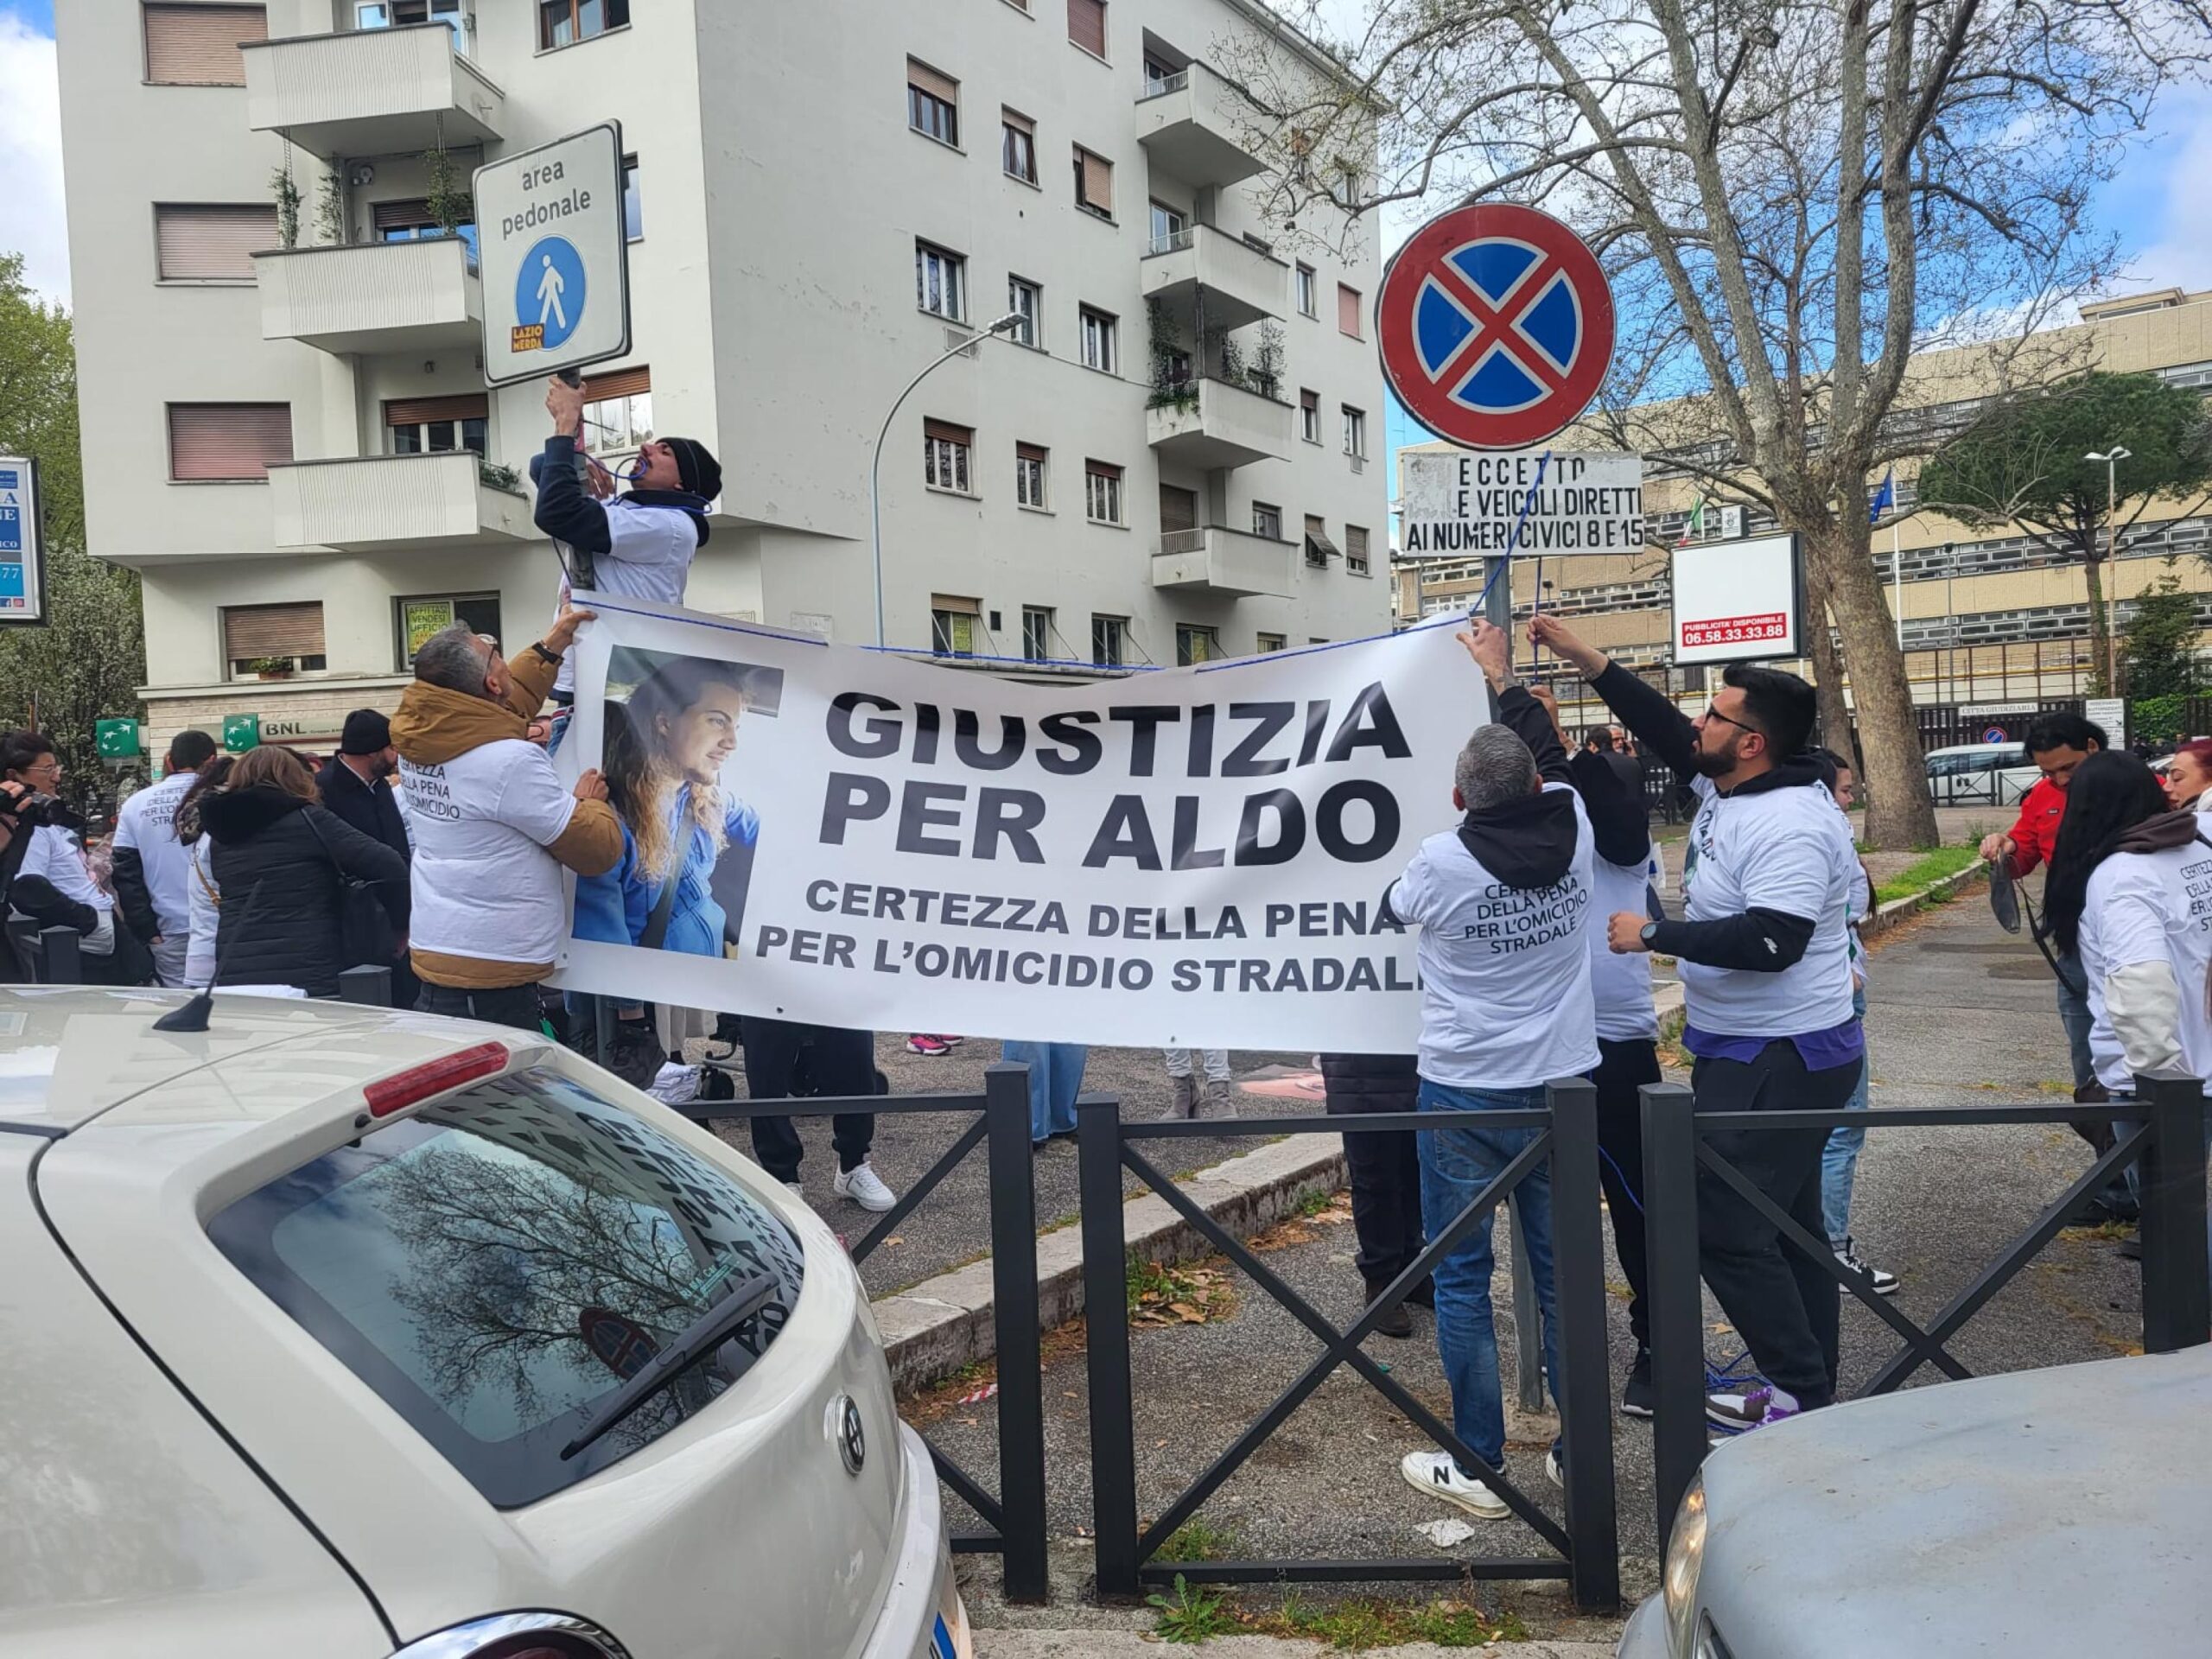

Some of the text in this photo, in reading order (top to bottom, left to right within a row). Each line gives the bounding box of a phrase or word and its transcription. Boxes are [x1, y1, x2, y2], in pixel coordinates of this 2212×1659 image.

[522, 161, 564, 191] area
[502, 188, 591, 240] pedonale
[513, 325, 543, 339] LAZIO
[1459, 457, 1585, 486] ECCETTO
[1458, 487, 1642, 518] E VEICOLI DIRETTI
[1407, 518, 1643, 550] AI NUMERI CIVICI 8 E 15
[1685, 624, 1783, 645] 06.58.33.33.88
[1733, 615, 1783, 626] DISPONIBILE
[265, 721, 307, 735] BNL
[825, 682, 1412, 777] GIUSTIZIA
[421, 779, 450, 799] PENA
[818, 772, 1401, 870] PER ALDO
[805, 880, 1407, 940] CERTEZZA DELLA PENA
[1465, 888, 1587, 939] PER L'OMICIDIO
[1478, 877, 1578, 920] DELLA PENA
[1491, 916, 1577, 954] STRADALE
[756, 925, 1424, 992] PER L'OMICIDIO STRADAL
[1433, 1465, 1450, 1484] N
